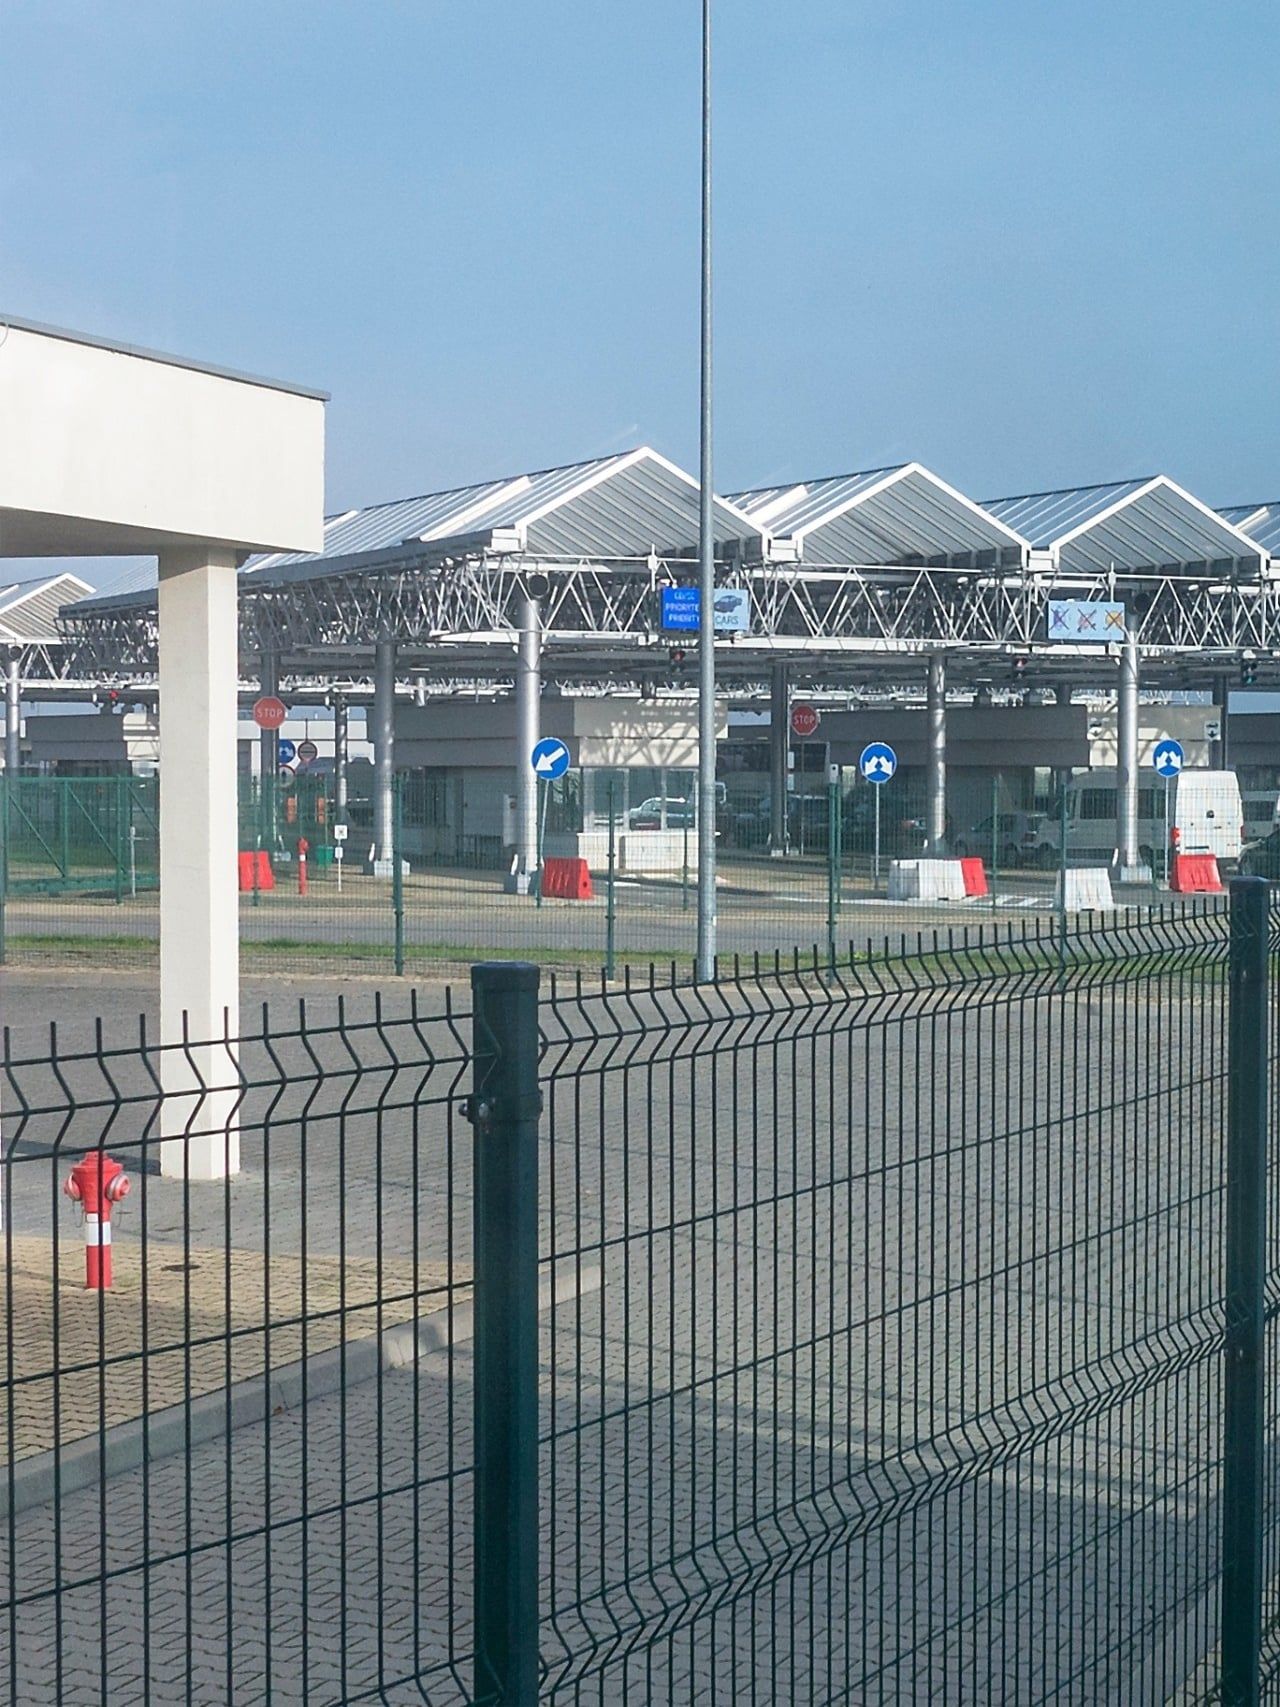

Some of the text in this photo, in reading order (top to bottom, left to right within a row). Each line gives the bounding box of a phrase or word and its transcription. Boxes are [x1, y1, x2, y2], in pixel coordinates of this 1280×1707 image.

[715, 615, 739, 625] CARS
[257, 708, 283, 718] STOP
[794, 714, 815, 725] STOP
